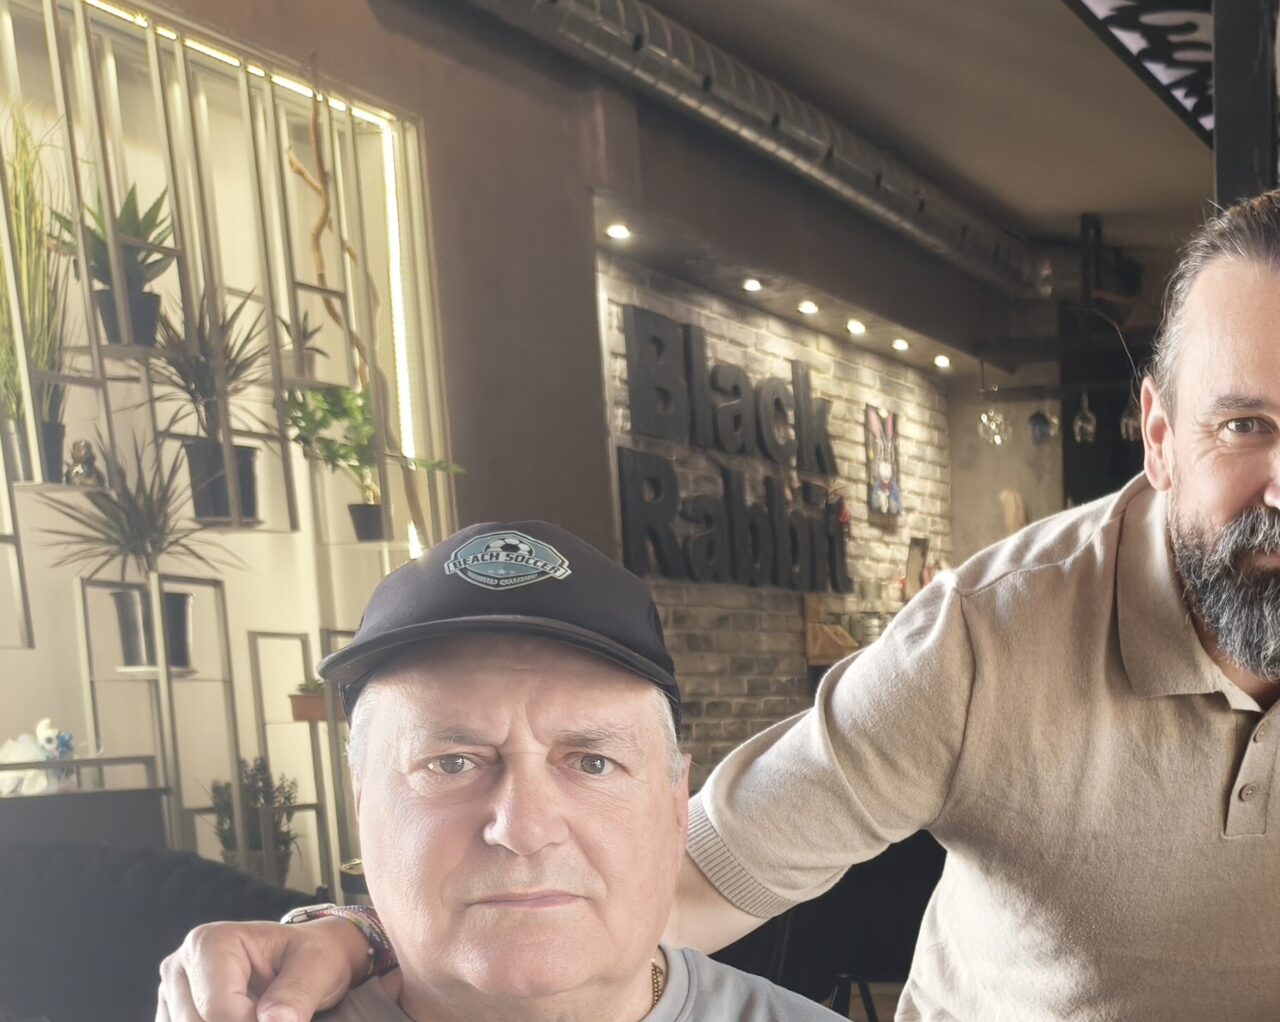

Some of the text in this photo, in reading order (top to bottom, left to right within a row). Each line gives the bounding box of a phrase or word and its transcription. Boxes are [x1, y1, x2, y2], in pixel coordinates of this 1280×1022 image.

[624, 304, 838, 476] Black
[453, 552, 562, 574] BEACH SOCCER
[617, 446, 854, 594] Rabbit
